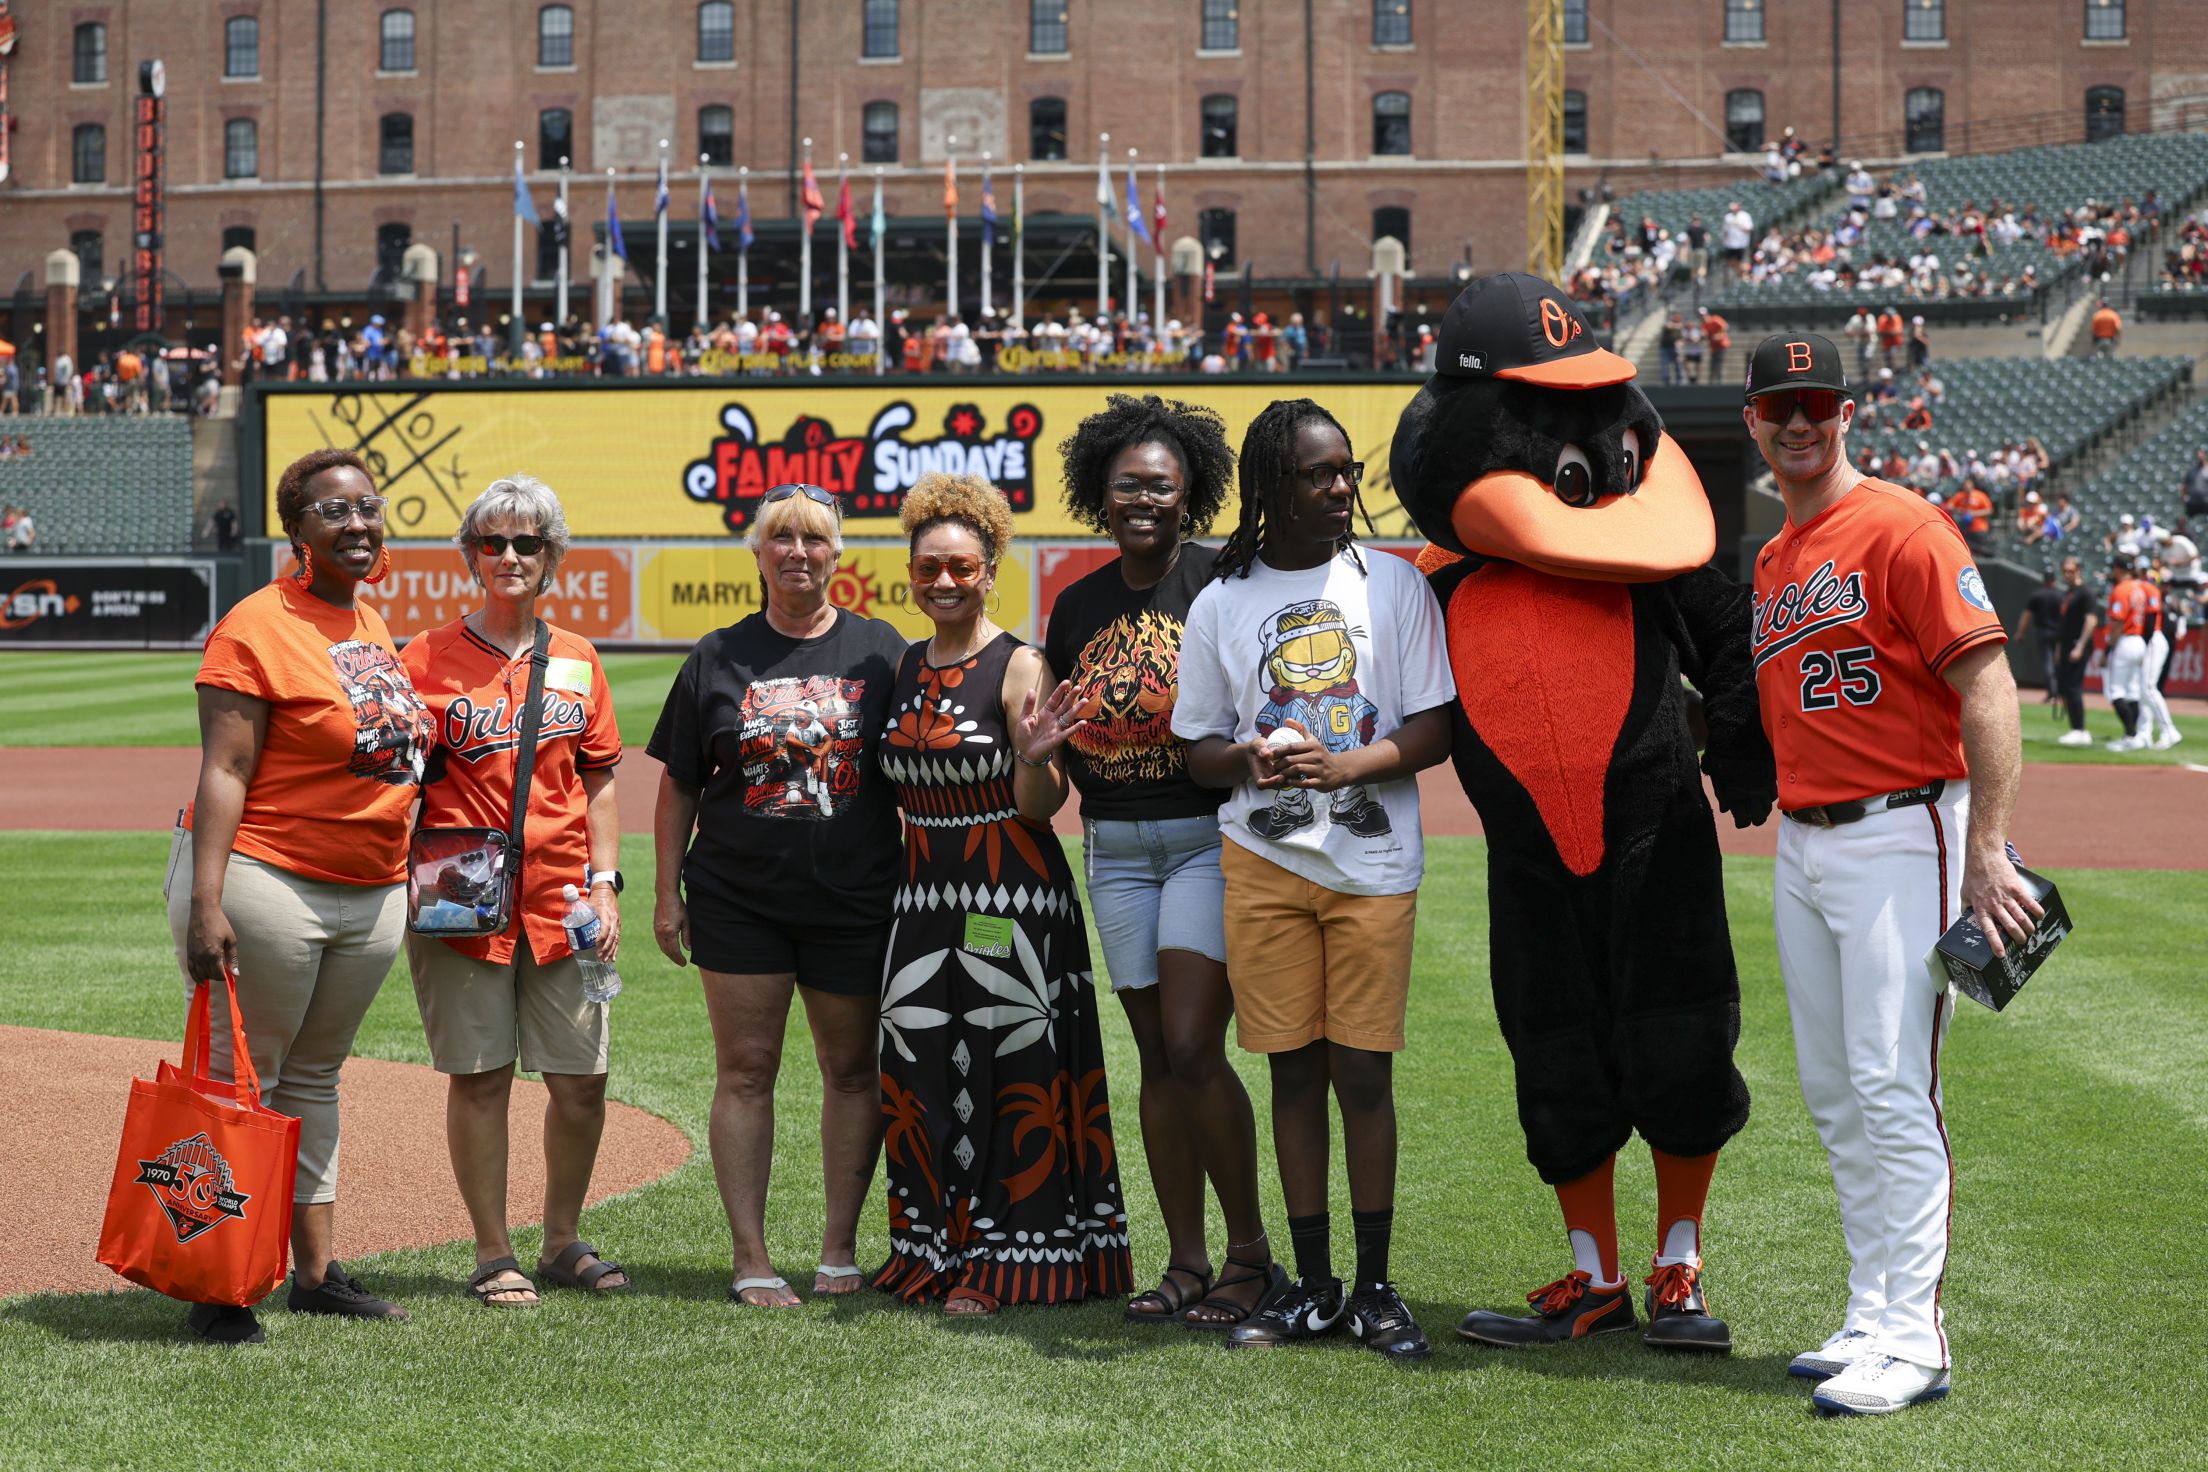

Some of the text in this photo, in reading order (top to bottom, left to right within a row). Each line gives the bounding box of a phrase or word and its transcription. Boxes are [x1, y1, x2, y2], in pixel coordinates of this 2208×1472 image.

[1540, 298, 1582, 347] O's
[1459, 353, 1482, 370] fello.
[1785, 341, 1813, 373] B
[716, 440, 864, 499] FAMILY
[354, 571, 608, 600] AUTUM AKE
[672, 582, 761, 606] MARYL
[1800, 646, 1882, 712] 25
[753, 675, 836, 712] Orioles
[743, 718, 767, 731] MAKE
[838, 719, 858, 731] JUST
[1329, 704, 1352, 736] G
[740, 724, 774, 741] EVERY DAY
[839, 729, 859, 739] THINK
[366, 741, 379, 754] UP
[741, 733, 774, 757] A WIN
[755, 775, 766, 786] UP
[584, 924, 601, 936] DEE
[585, 931, 600, 943] PAR
[965, 942, 1010, 957] Orioles
[146, 1168, 171, 1181] 1970
[169, 1162, 217, 1210] 50
[217, 1200, 238, 1211] CHAMPS
[219, 1196, 238, 1206] WORLD
[166, 1199, 214, 1223] ANNIVERSARY
